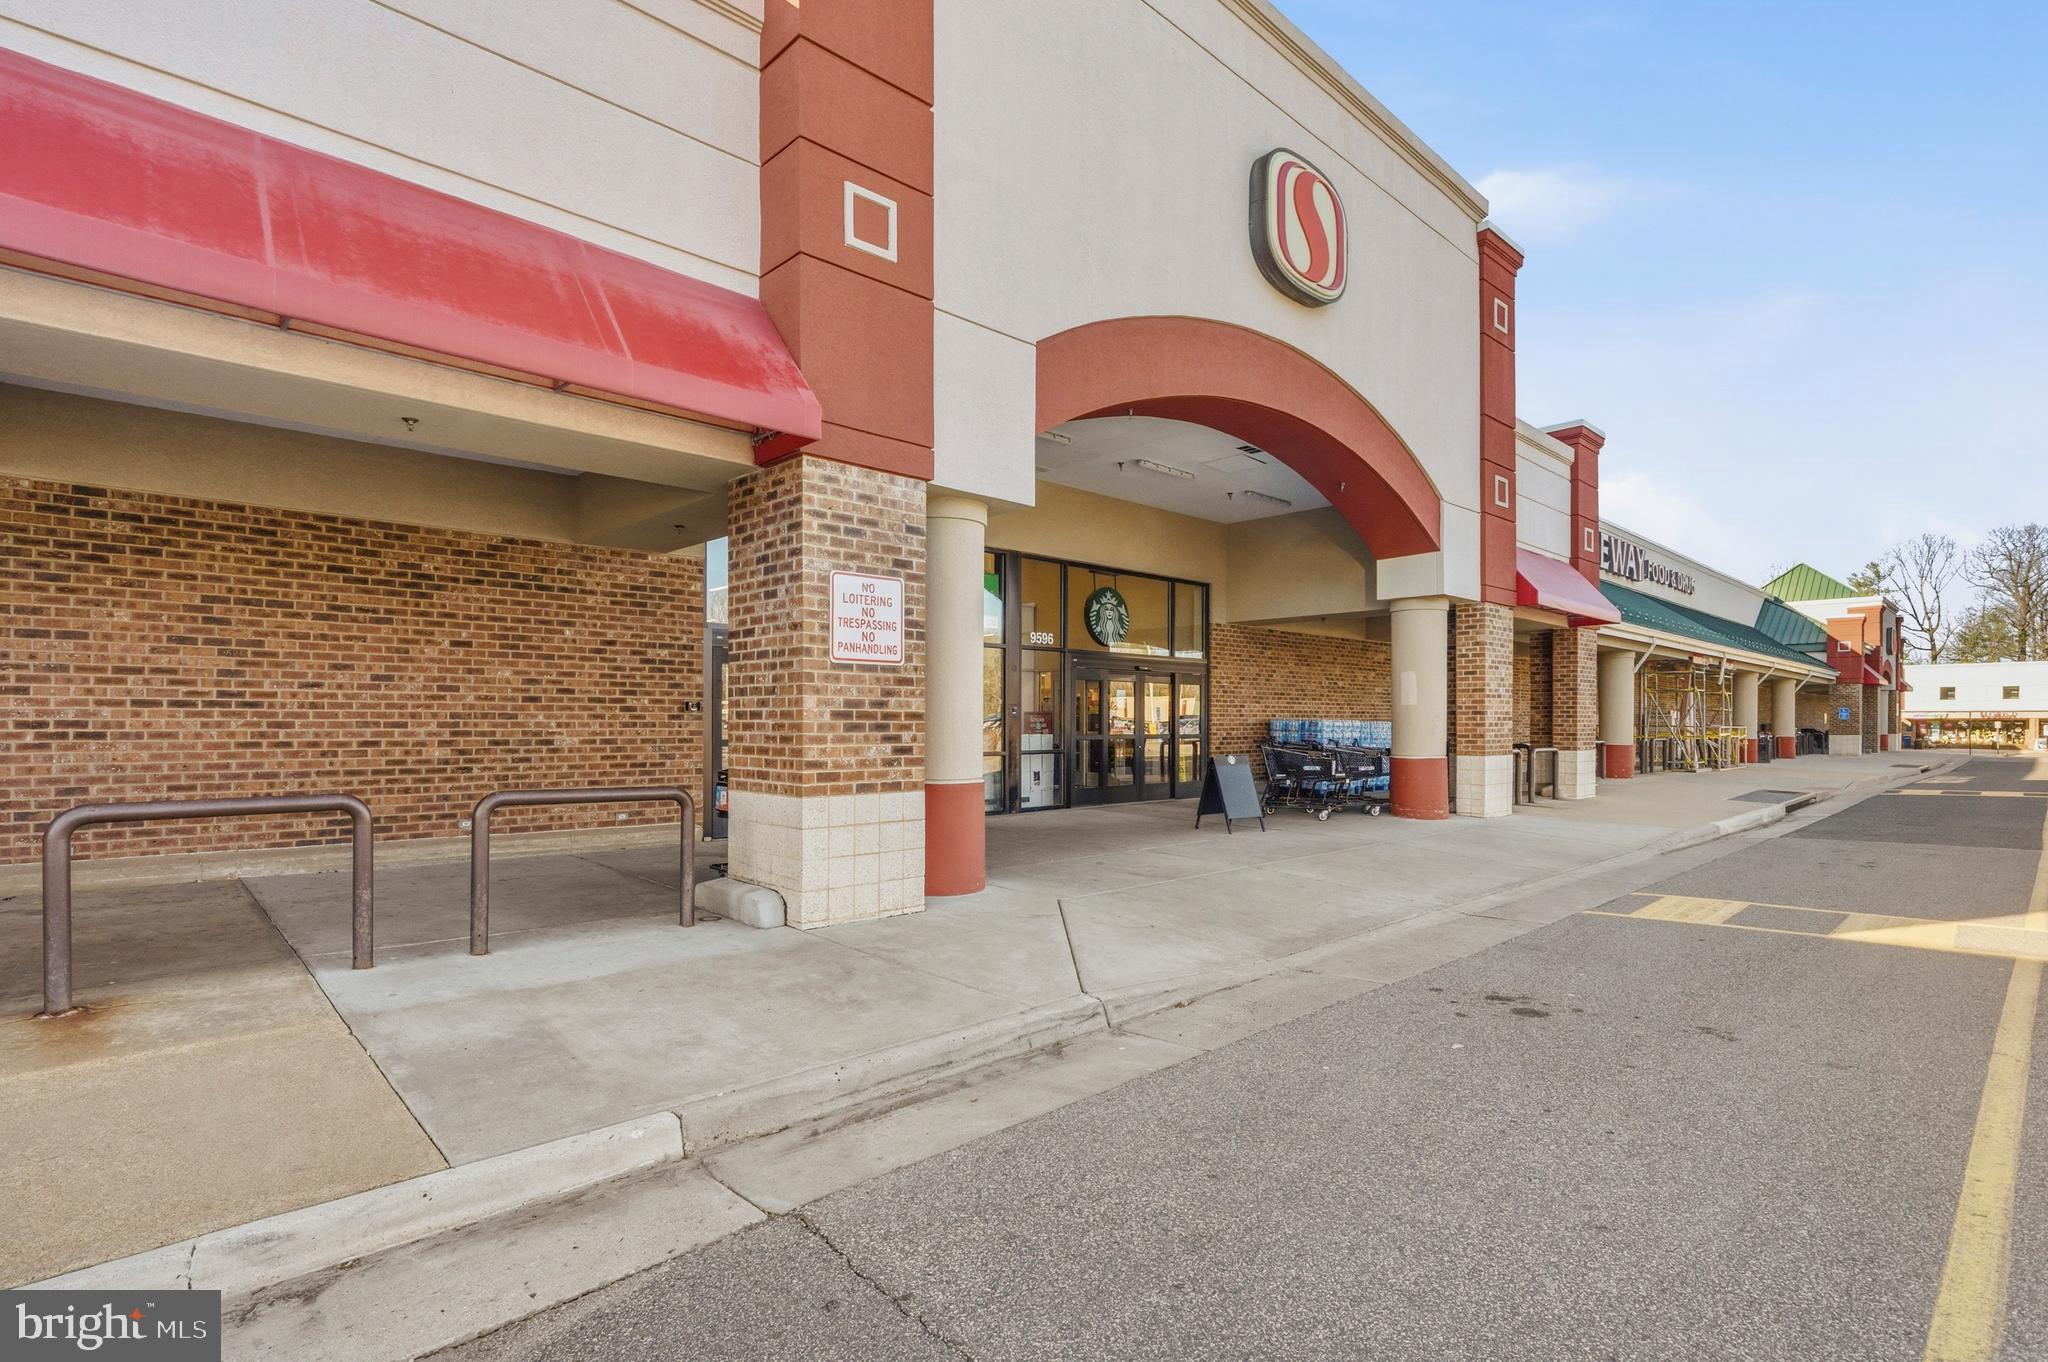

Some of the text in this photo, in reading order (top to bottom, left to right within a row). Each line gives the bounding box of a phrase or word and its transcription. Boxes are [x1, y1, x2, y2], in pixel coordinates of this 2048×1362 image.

[1600, 532, 1645, 582] EWAY
[1648, 562, 1670, 584] FOOD
[861, 583, 875, 593] NO
[842, 592, 893, 608] LOITERING
[861, 607, 875, 617] NO
[837, 616, 897, 632] TRESPASSING
[861, 632, 875, 642] NO
[1030, 631, 1054, 645] 9596
[837, 641, 898, 656] PANHANDLING
